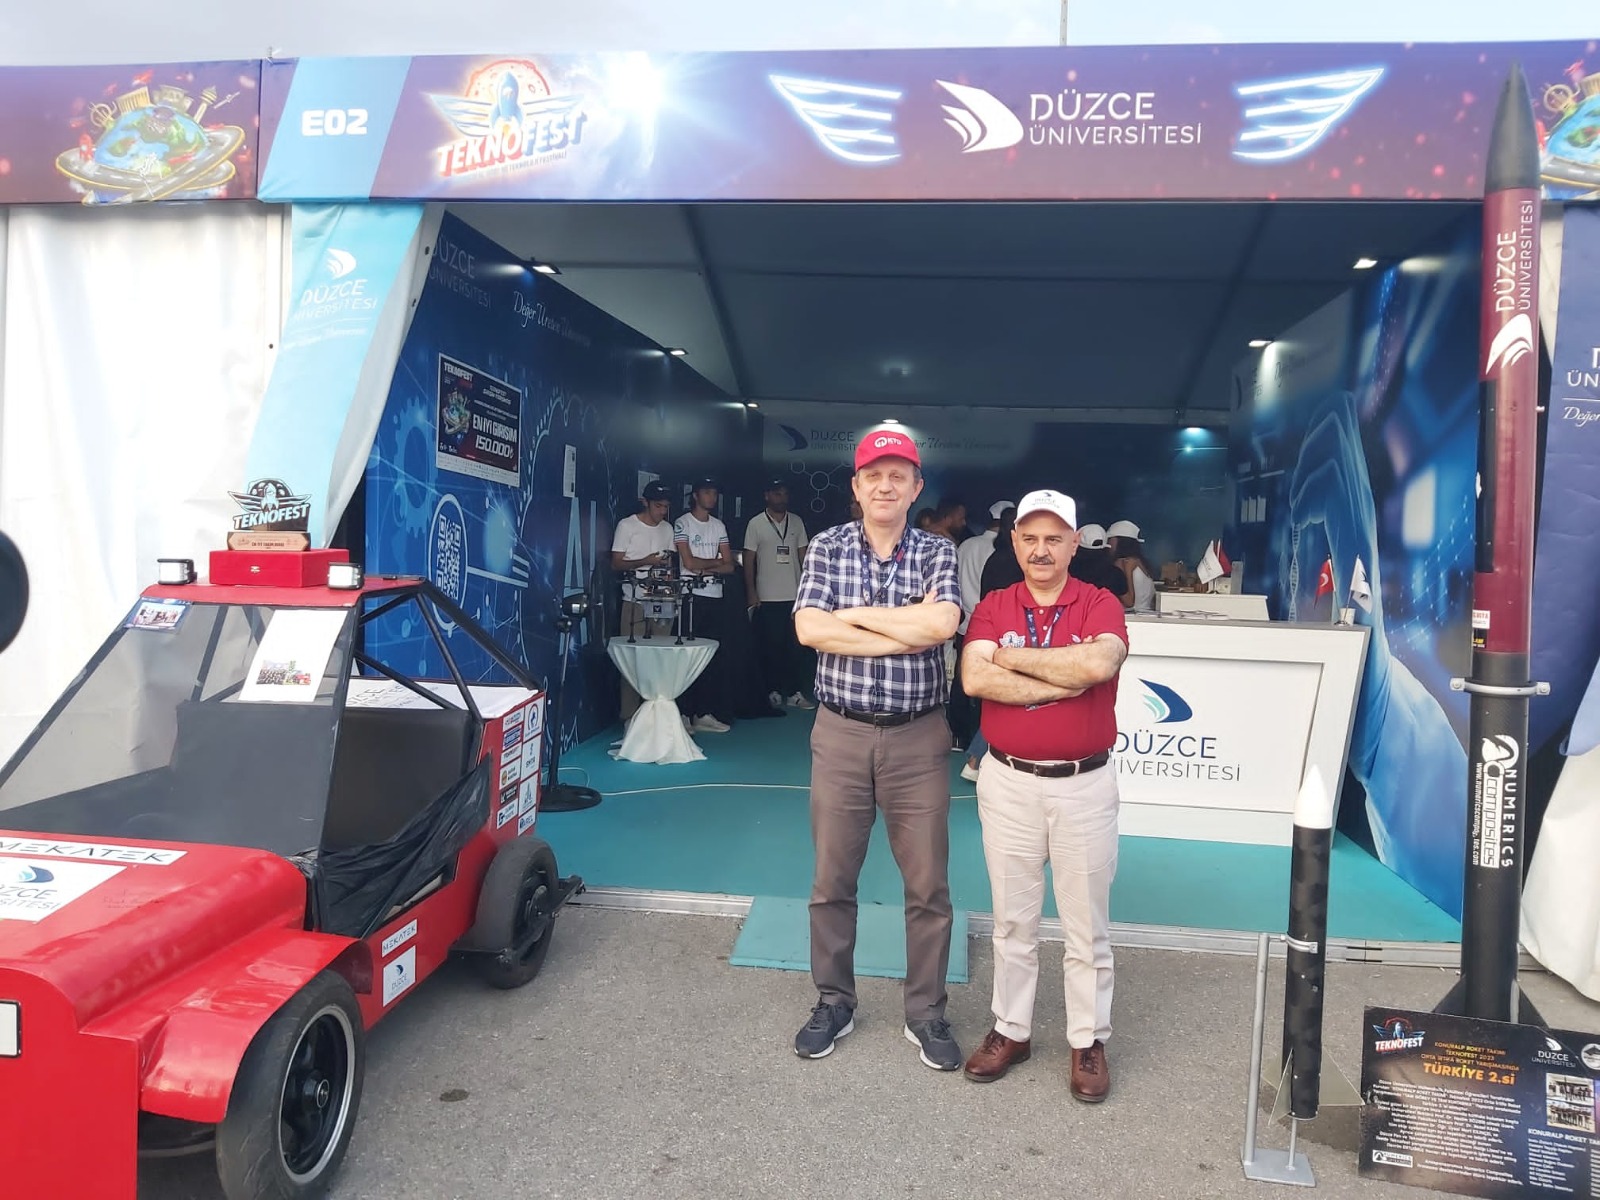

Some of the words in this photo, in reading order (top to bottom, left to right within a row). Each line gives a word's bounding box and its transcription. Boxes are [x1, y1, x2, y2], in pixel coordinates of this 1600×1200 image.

[1030, 88, 1155, 121] DÜZCE
[301, 109, 367, 136] E02
[1029, 122, 1202, 146] ÜNİVERSİTESİ
[437, 110, 587, 177] TEKNOFEST
[1516, 200, 1533, 311] ÜNİVERSİTESİ
[1494, 230, 1517, 313] DÜZCE
[301, 279, 368, 306] DÜZCE
[1567, 369, 1600, 388] ÜN
[233, 503, 310, 530] TEKNOFEST
[1110, 729, 1217, 759] DÜZCE
[1113, 757, 1241, 782] İVERSİTESİ
[1501, 769, 1519, 868] NUMERICS
[0, 841, 172, 862] MEKATEK
[0, 884, 57, 899] ZCE
[383, 924, 416, 952] MEKATEK
[1375, 1037, 1424, 1052] TEKNOFEST
[1423, 1061, 1484, 1081] TÜRKİYE
